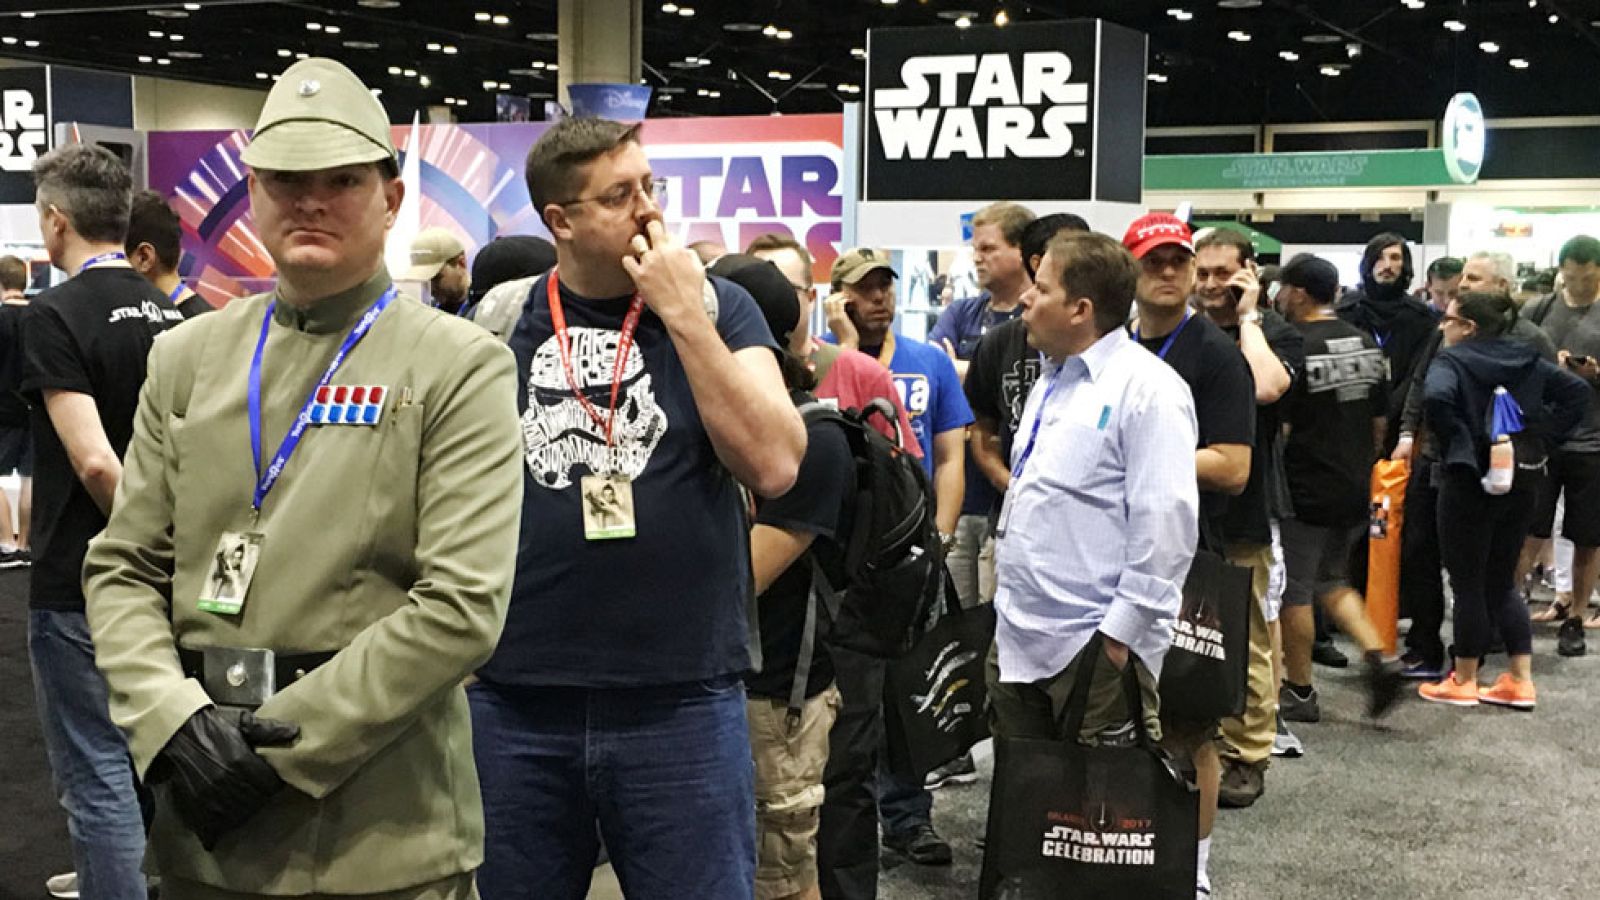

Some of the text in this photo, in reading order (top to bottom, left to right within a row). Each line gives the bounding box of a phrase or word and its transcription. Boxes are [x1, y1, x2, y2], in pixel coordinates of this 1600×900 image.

[874, 51, 1088, 109] STAR
[874, 104, 1087, 160] WARS
[1222, 156, 1369, 179] STAR WARS
[1044, 825, 1155, 847] STAR WARS
[1042, 839, 1155, 865] CELEBRATION
